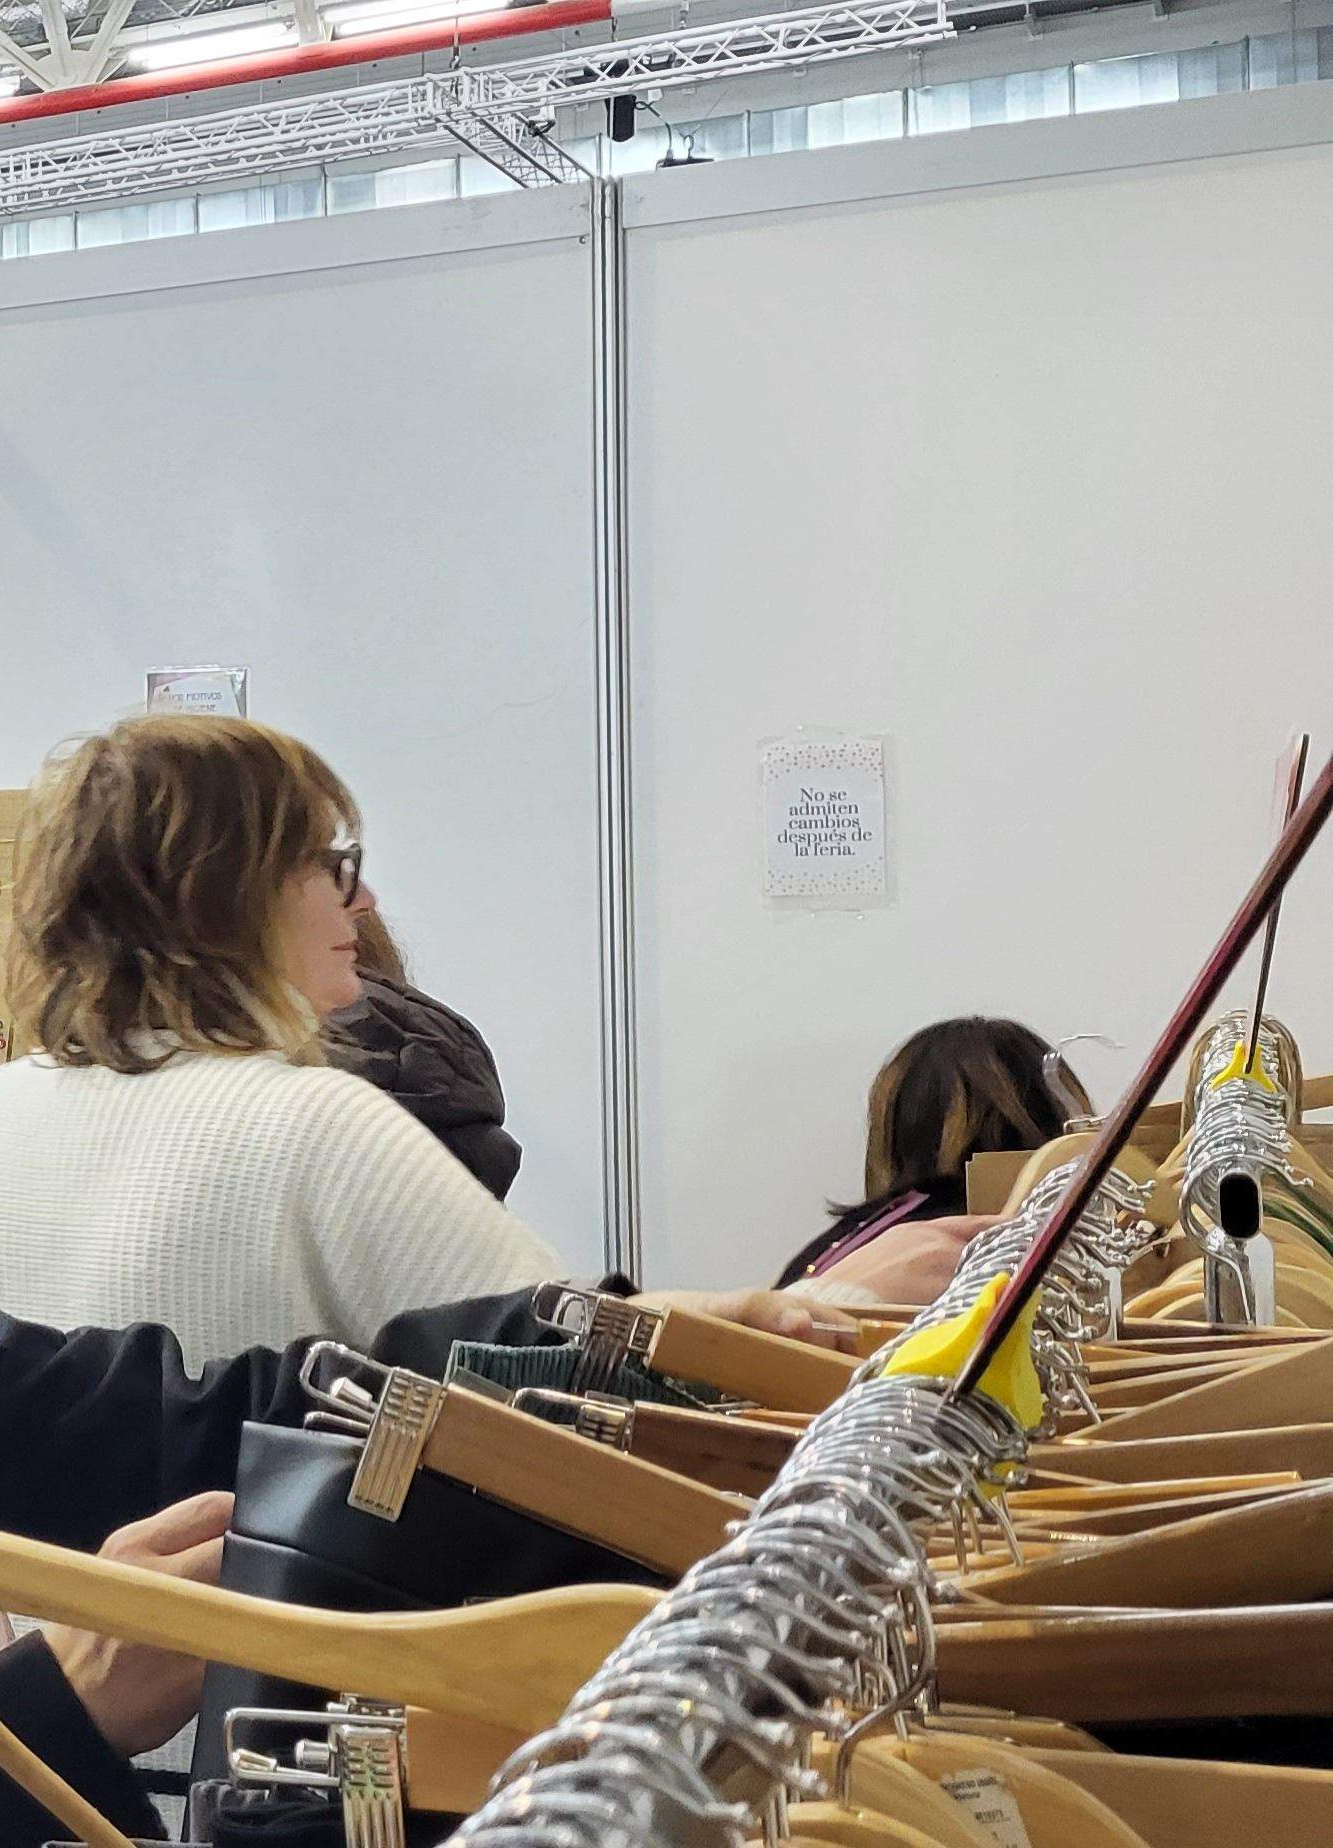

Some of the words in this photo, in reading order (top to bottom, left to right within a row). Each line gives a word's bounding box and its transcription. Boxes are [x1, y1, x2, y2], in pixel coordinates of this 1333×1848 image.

[800, 788, 825, 802] No
[829, 790, 847, 801] se
[789, 801, 859, 816] admiten
[788, 814, 861, 830] cambios
[777, 828, 847, 847] después
[851, 827, 873, 842] de
[795, 843, 809, 857] la
[813, 841, 856, 857] feria.
